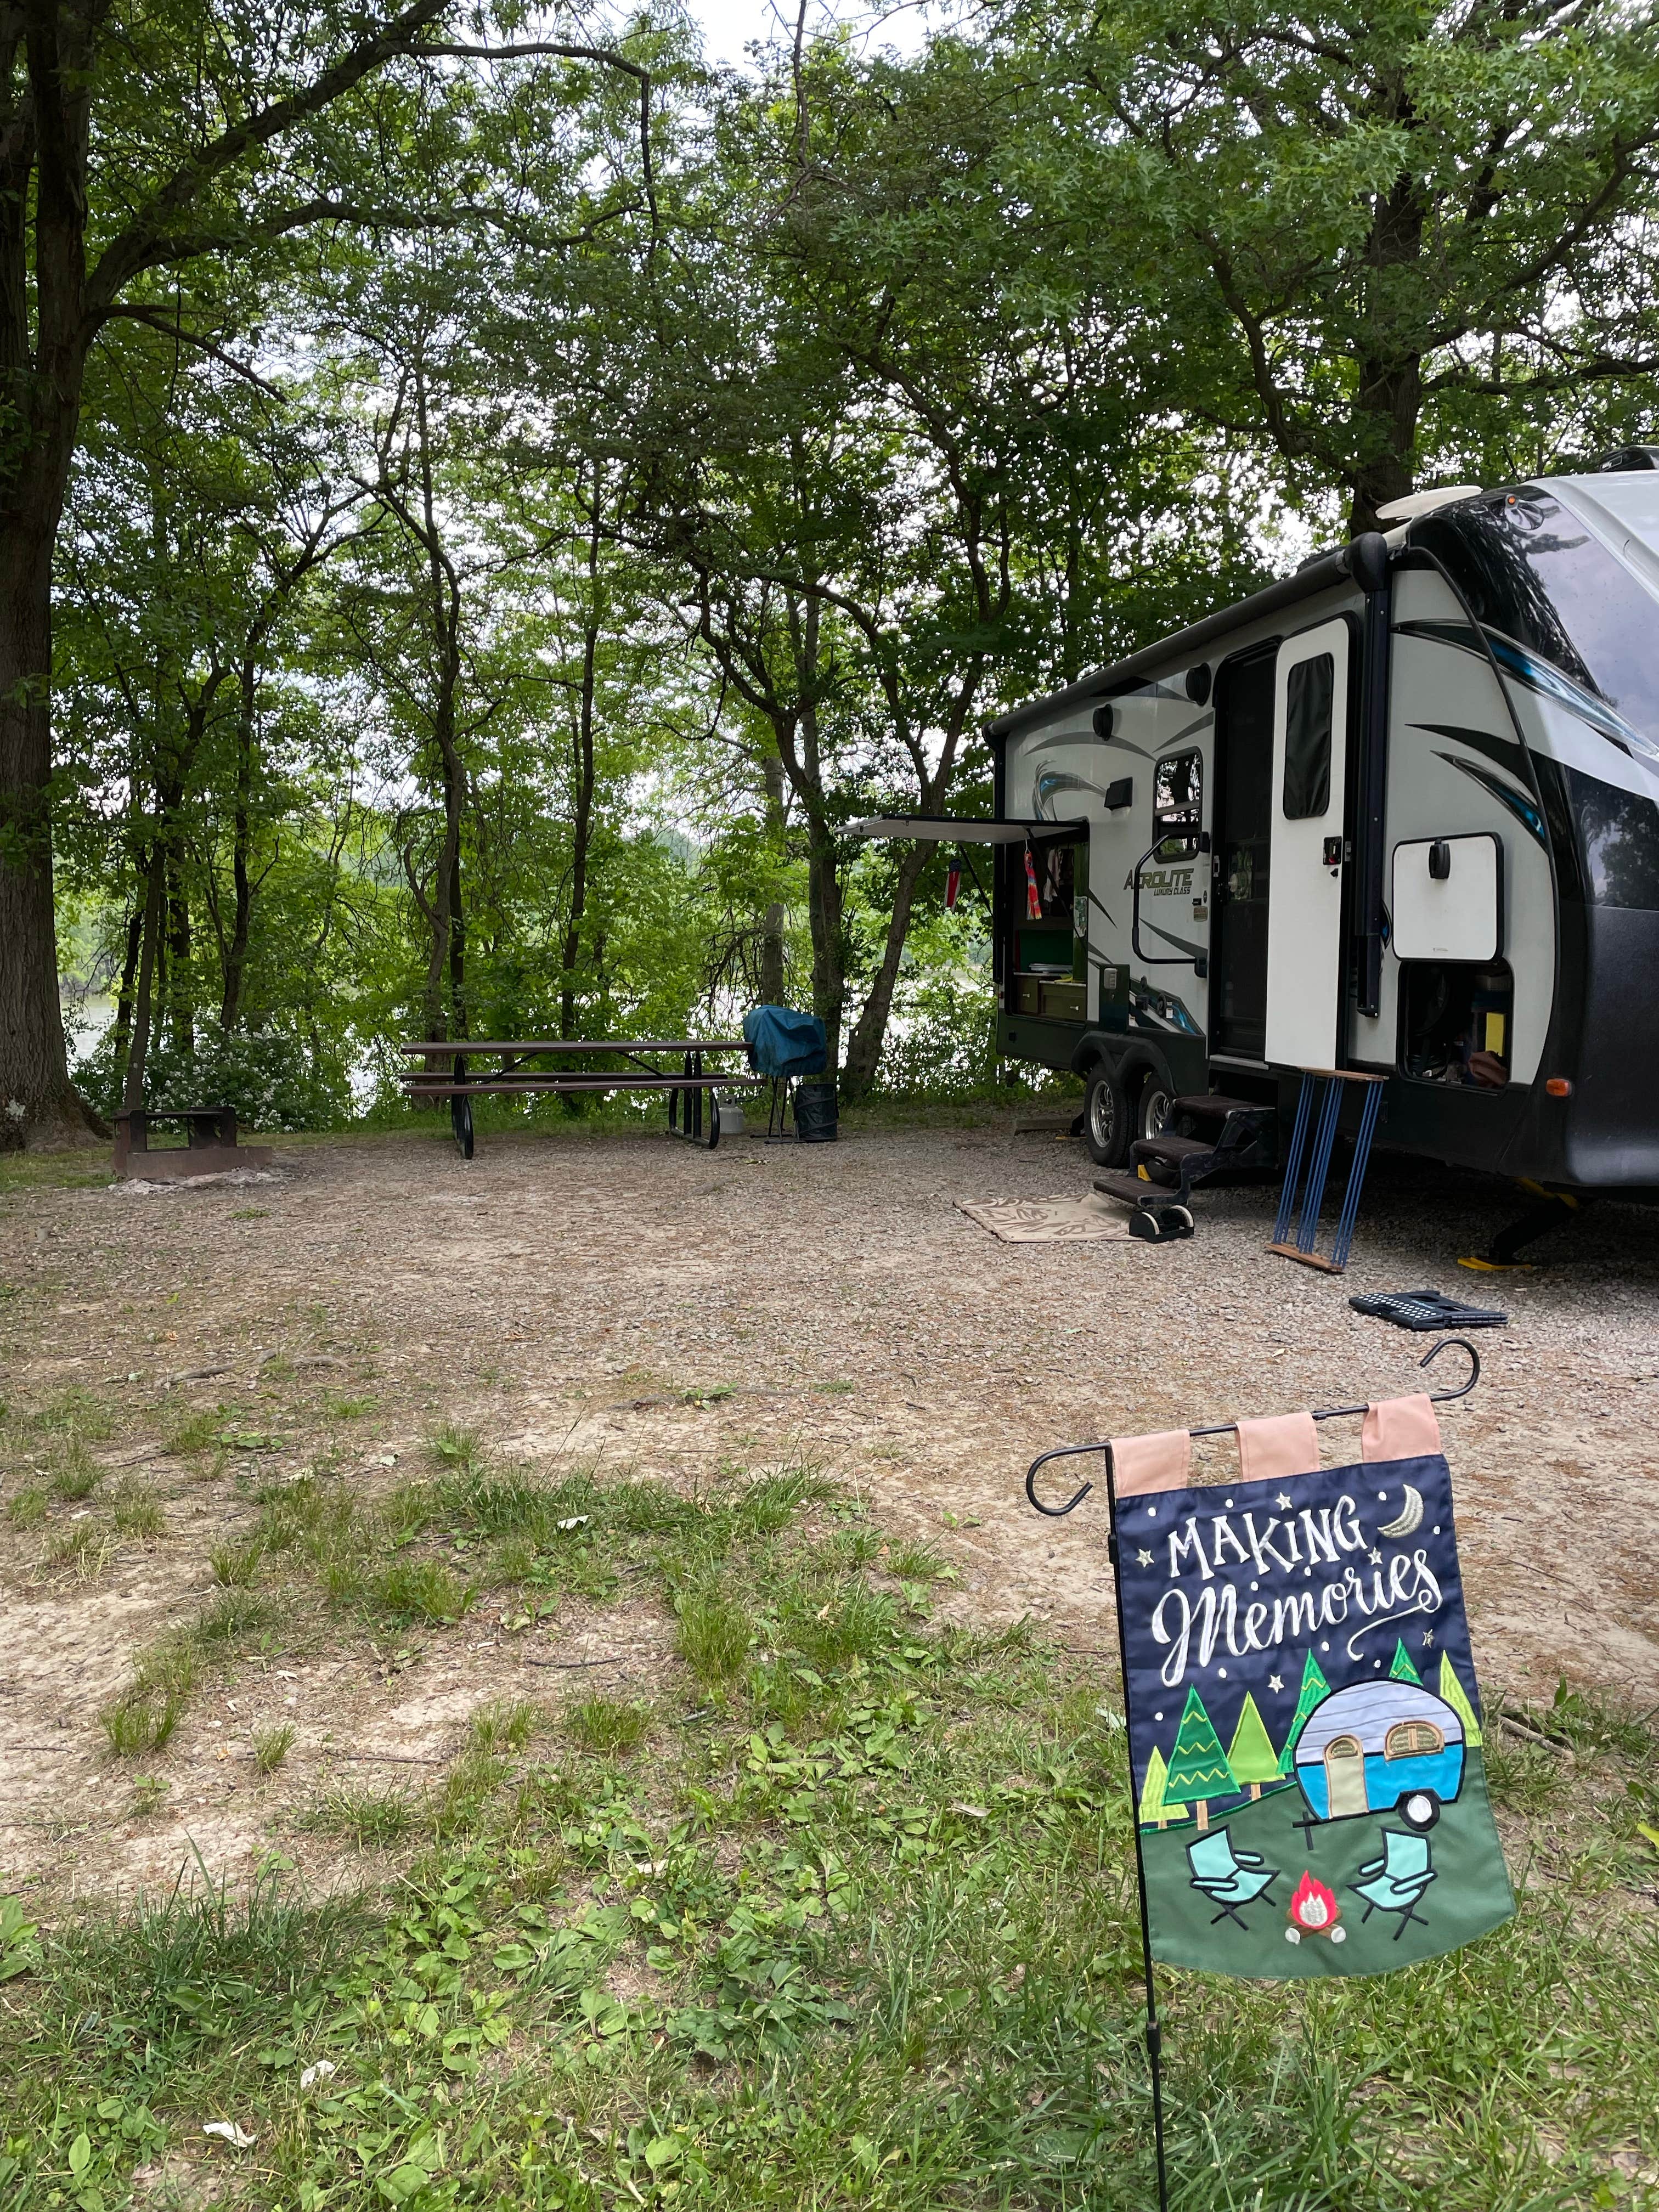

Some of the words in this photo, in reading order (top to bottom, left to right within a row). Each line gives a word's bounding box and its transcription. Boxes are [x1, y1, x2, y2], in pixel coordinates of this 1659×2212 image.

[1154, 888, 1173, 896] LUXURY
[1173, 887, 1190, 895] CLASS
[1168, 1495, 1368, 1580] MAKING
[1152, 1549, 1443, 1688] Memories
